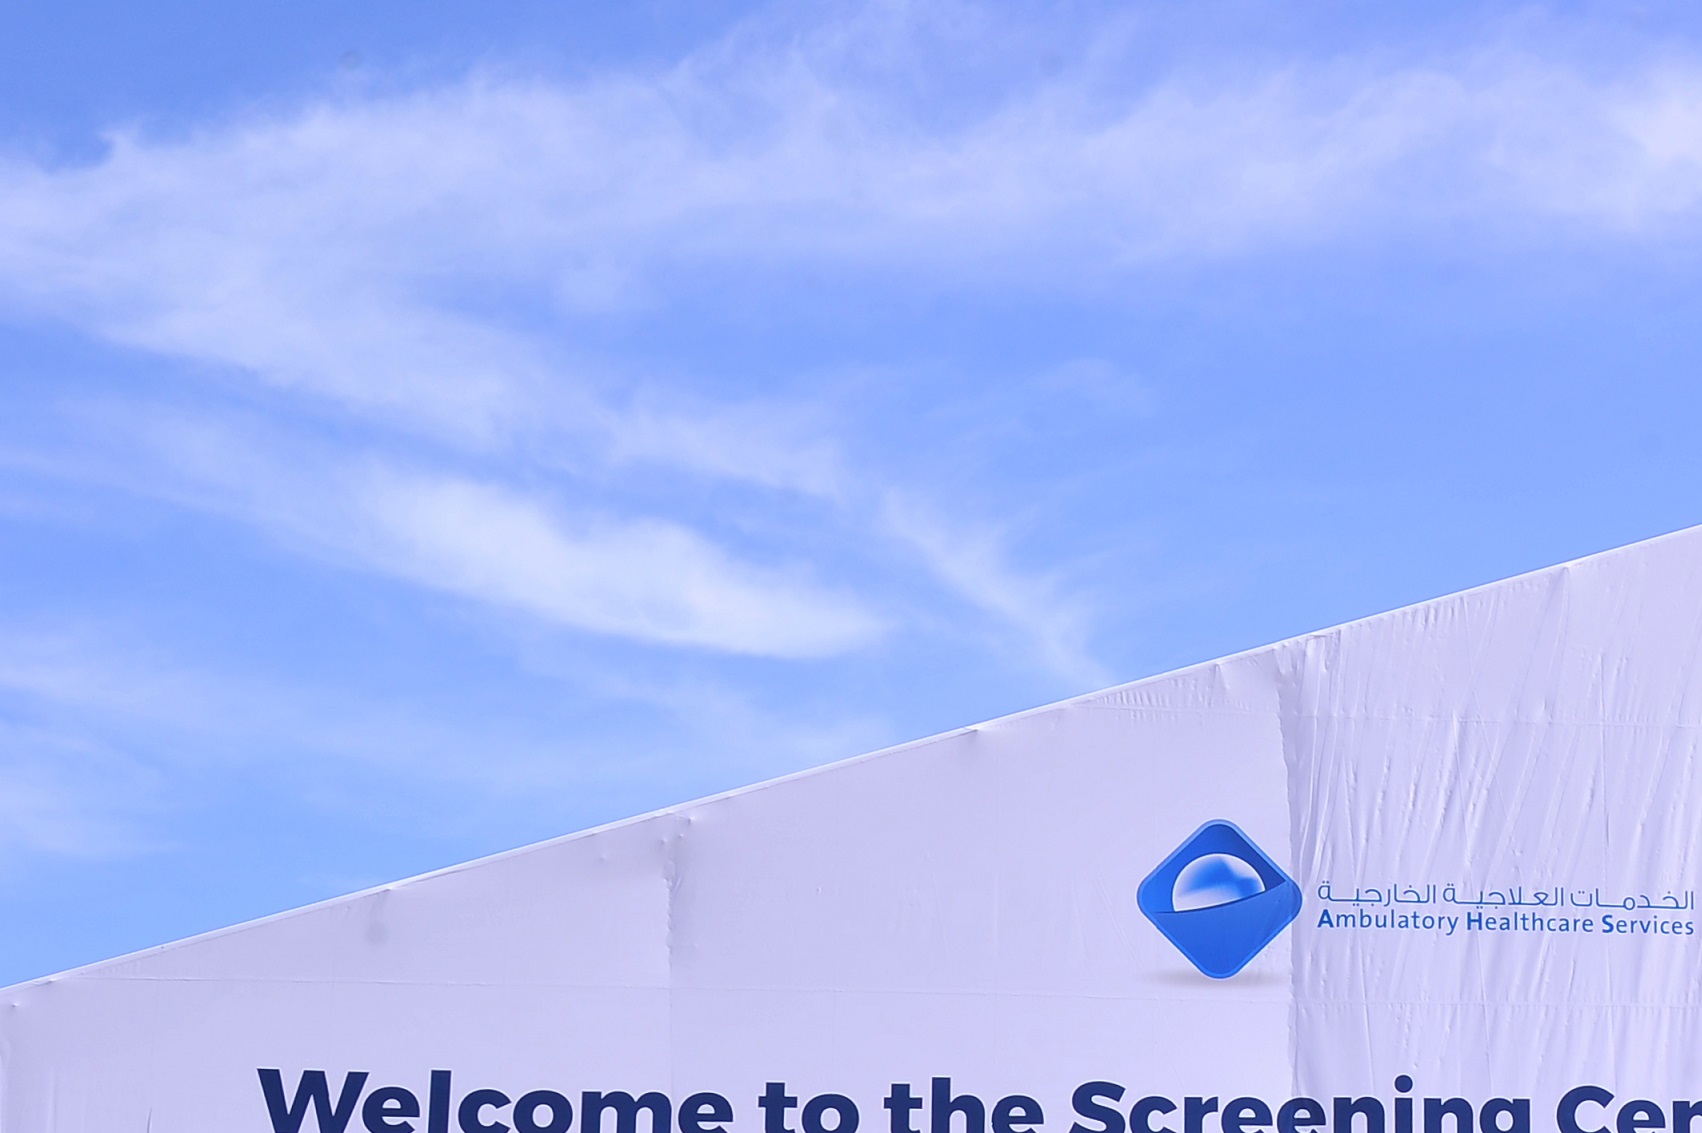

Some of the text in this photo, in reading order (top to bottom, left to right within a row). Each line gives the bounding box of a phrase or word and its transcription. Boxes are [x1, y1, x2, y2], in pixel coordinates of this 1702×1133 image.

[1317, 881, 1695, 911] الخدمات العلاجية الخارجية
[1317, 908, 1694, 937] Ambulatory Healthcare Services
